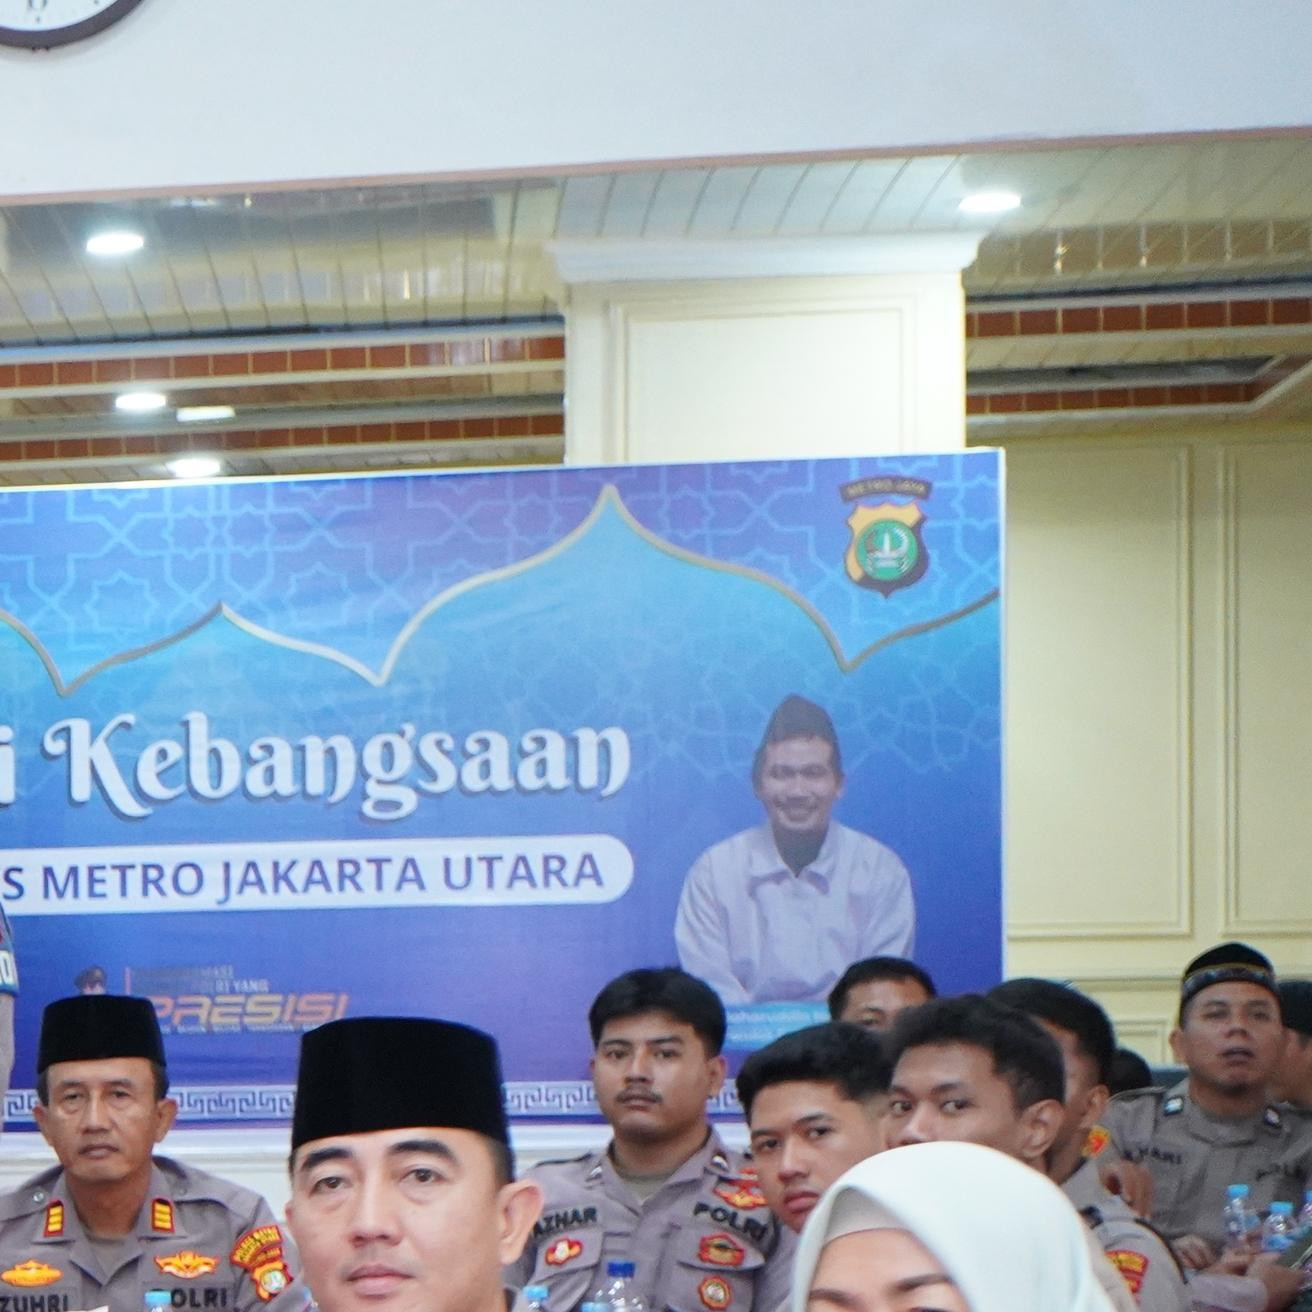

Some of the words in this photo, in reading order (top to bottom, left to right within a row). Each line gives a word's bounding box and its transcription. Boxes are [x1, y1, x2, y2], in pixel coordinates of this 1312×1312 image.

[43, 711, 631, 820] Kebangsaan
[42, 861, 205, 901] METRO
[216, 855, 426, 904] JAKARTA
[442, 852, 604, 891] UTARA
